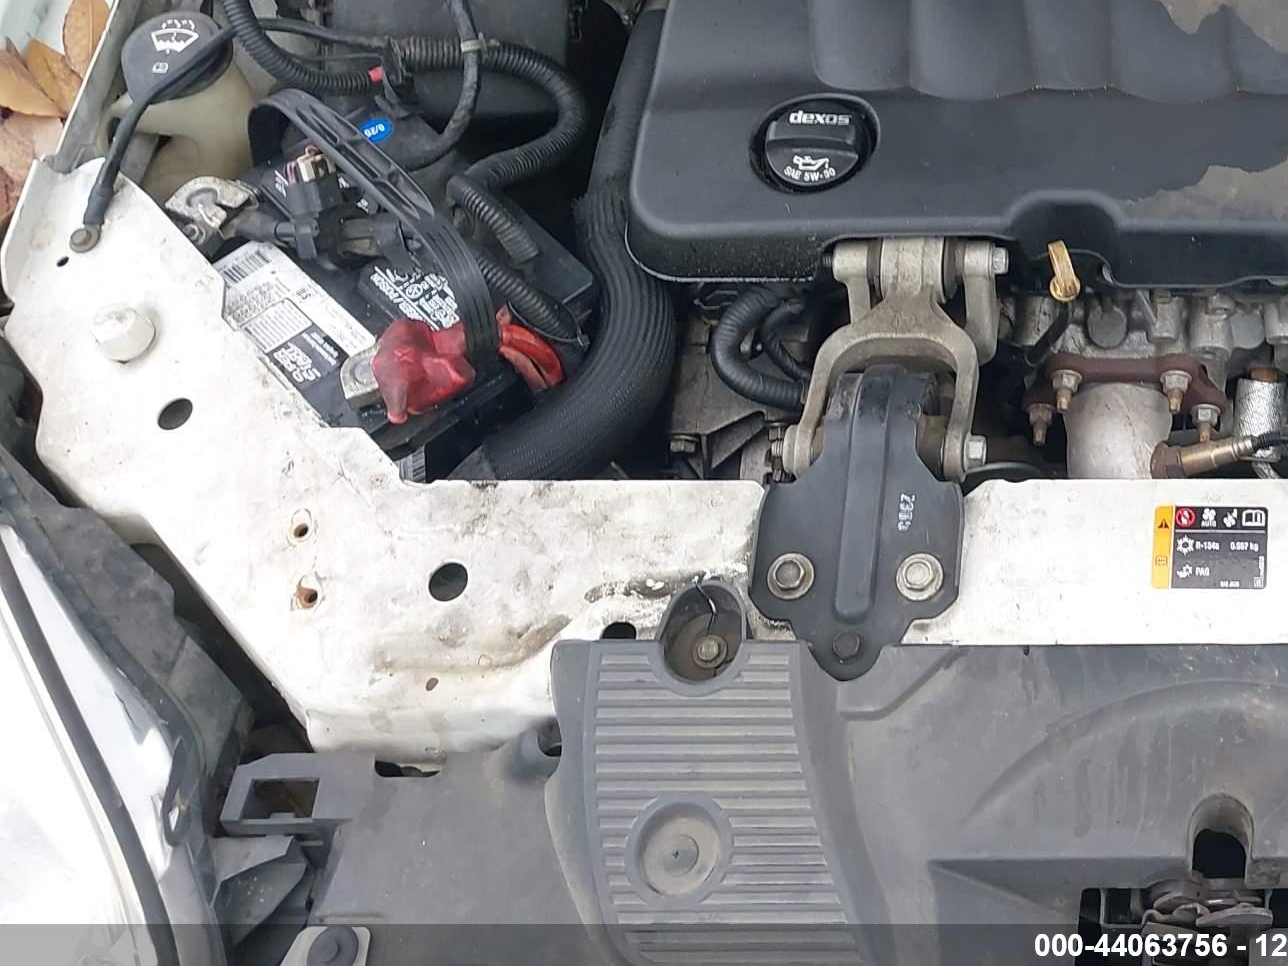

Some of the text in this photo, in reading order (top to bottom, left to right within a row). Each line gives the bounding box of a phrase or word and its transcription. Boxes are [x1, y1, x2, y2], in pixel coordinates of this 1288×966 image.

[789, 110, 852, 126] dexos
[784, 165, 836, 182] SAE 5W-30
[1250, 541, 1259, 552] kg
